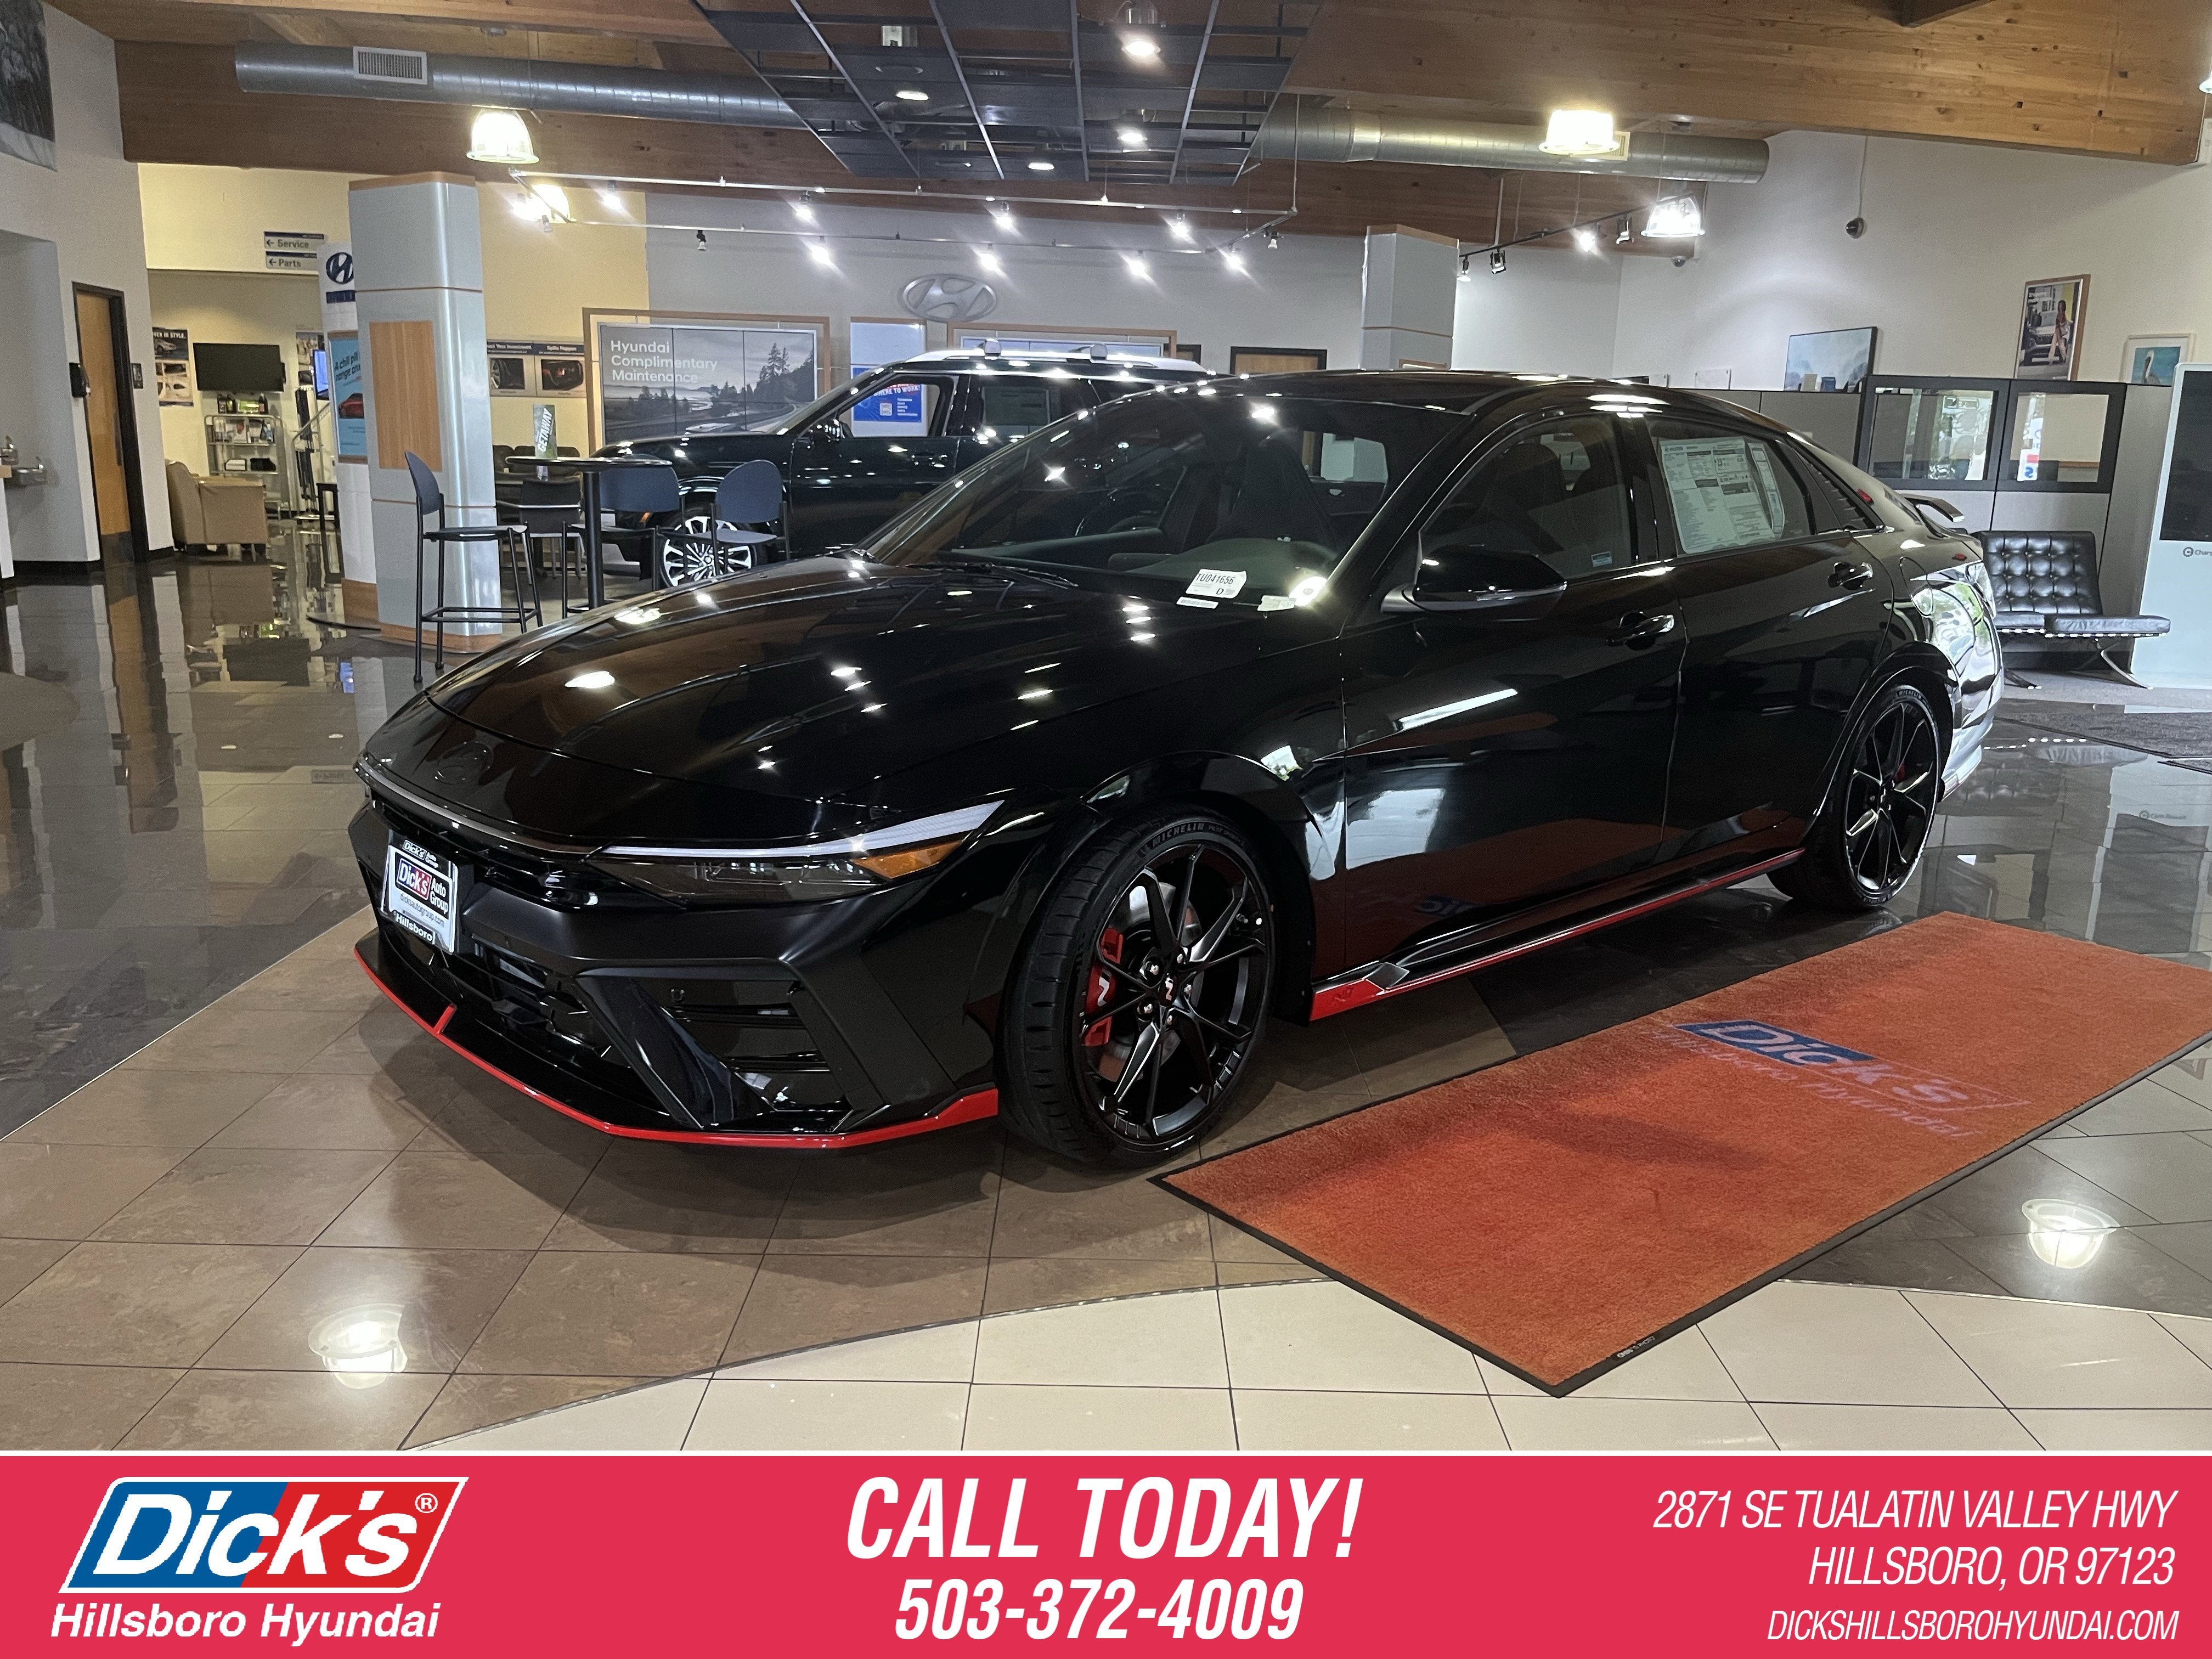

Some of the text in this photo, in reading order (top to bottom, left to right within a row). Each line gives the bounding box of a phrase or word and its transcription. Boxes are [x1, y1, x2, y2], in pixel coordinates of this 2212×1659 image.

[278, 239, 309, 249] Service
[279, 258, 301, 267] Parts
[610, 340, 670, 354] Hyundai
[611, 355, 718, 371] Complimentary
[612, 370, 698, 383] Maintenance
[538, 408, 552, 453] GETAWAY
[1195, 573, 1235, 585] TU041656
[1153, 823, 1205, 847] MICHELIN
[404, 842, 426, 858] Dick's
[399, 862, 430, 896] Dick's
[431, 878, 447, 898] Auto
[400, 894, 444, 928] dicksautogroup.com
[430, 892, 449, 915] Group
[396, 912, 433, 942] Hillsboro
